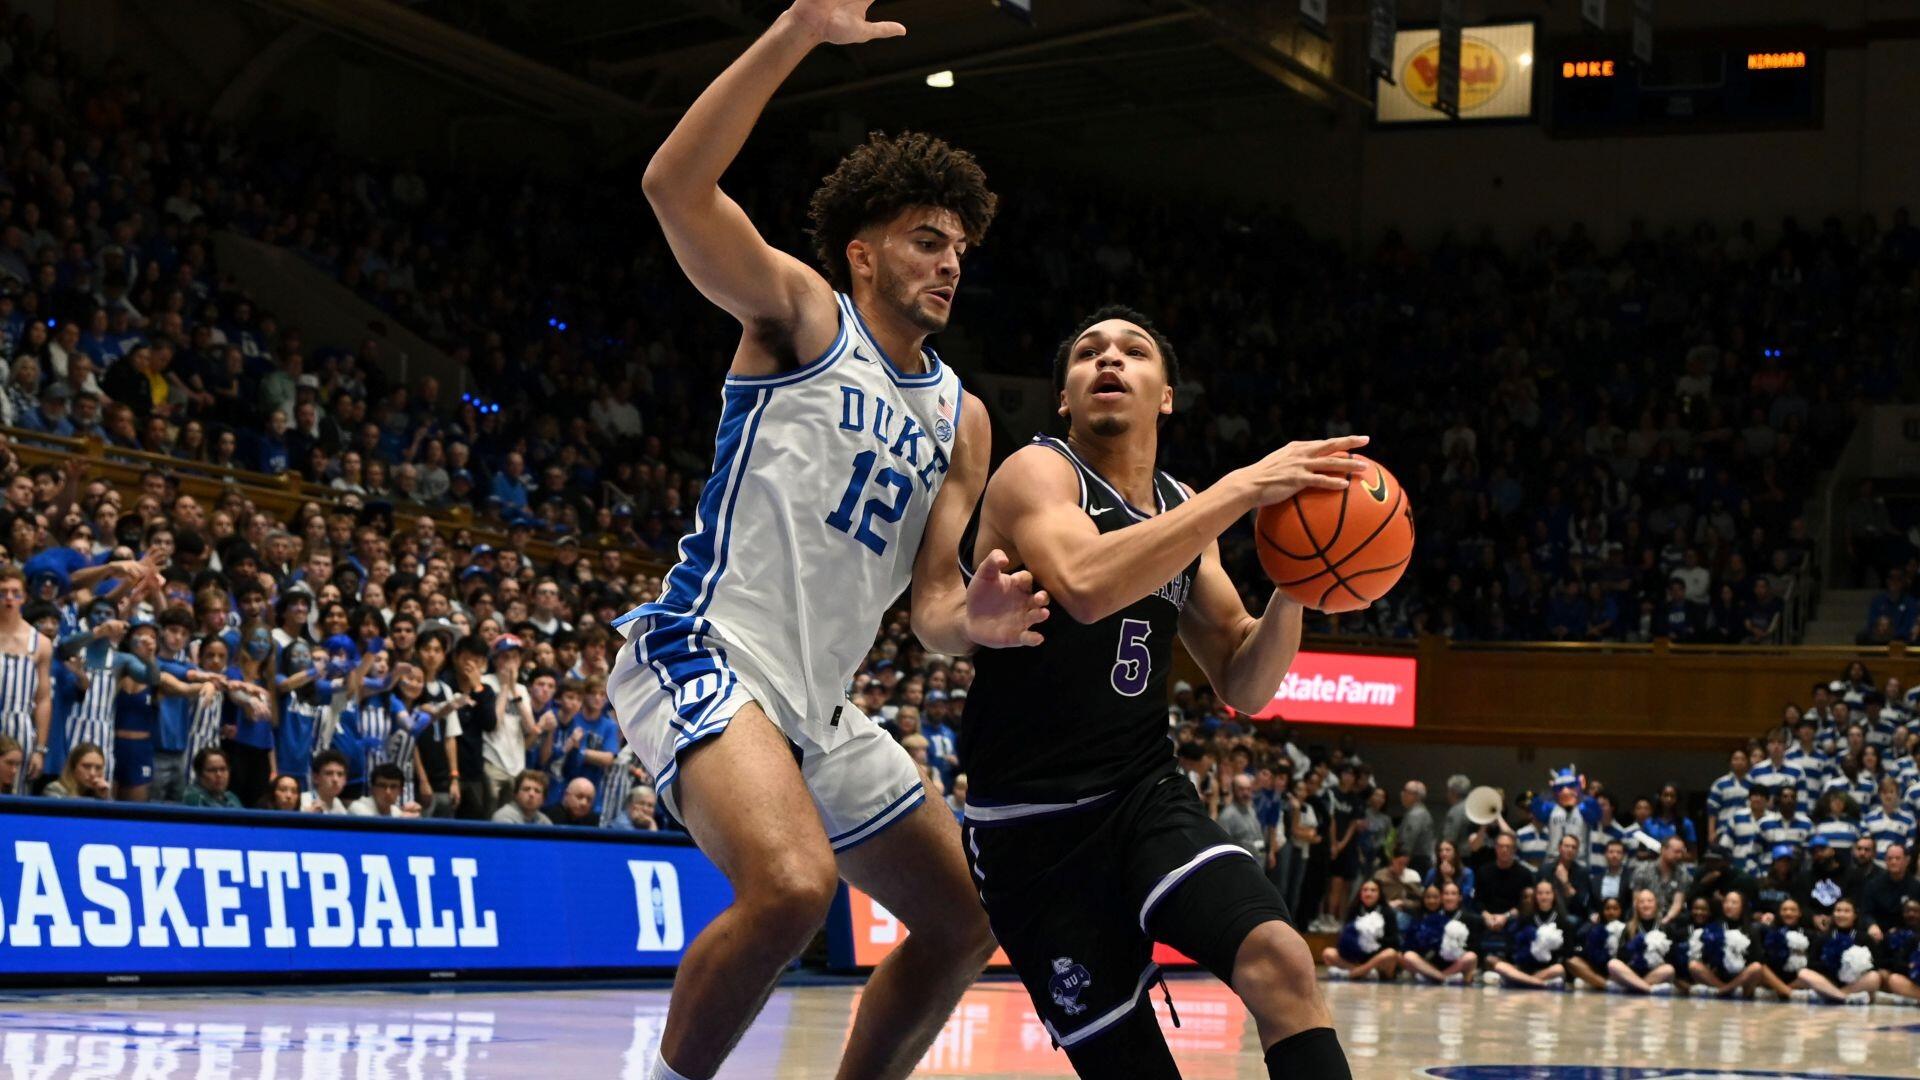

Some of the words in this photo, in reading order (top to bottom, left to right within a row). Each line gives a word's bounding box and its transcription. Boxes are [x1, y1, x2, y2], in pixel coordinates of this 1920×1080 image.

[1563, 60, 1614, 78] DUKE
[839, 385, 949, 493] DUKE
[825, 449, 914, 556] 12
[1110, 618, 1152, 697] 5
[0, 840, 499, 949] ASKETBALL
[1062, 973, 1079, 989] NU
